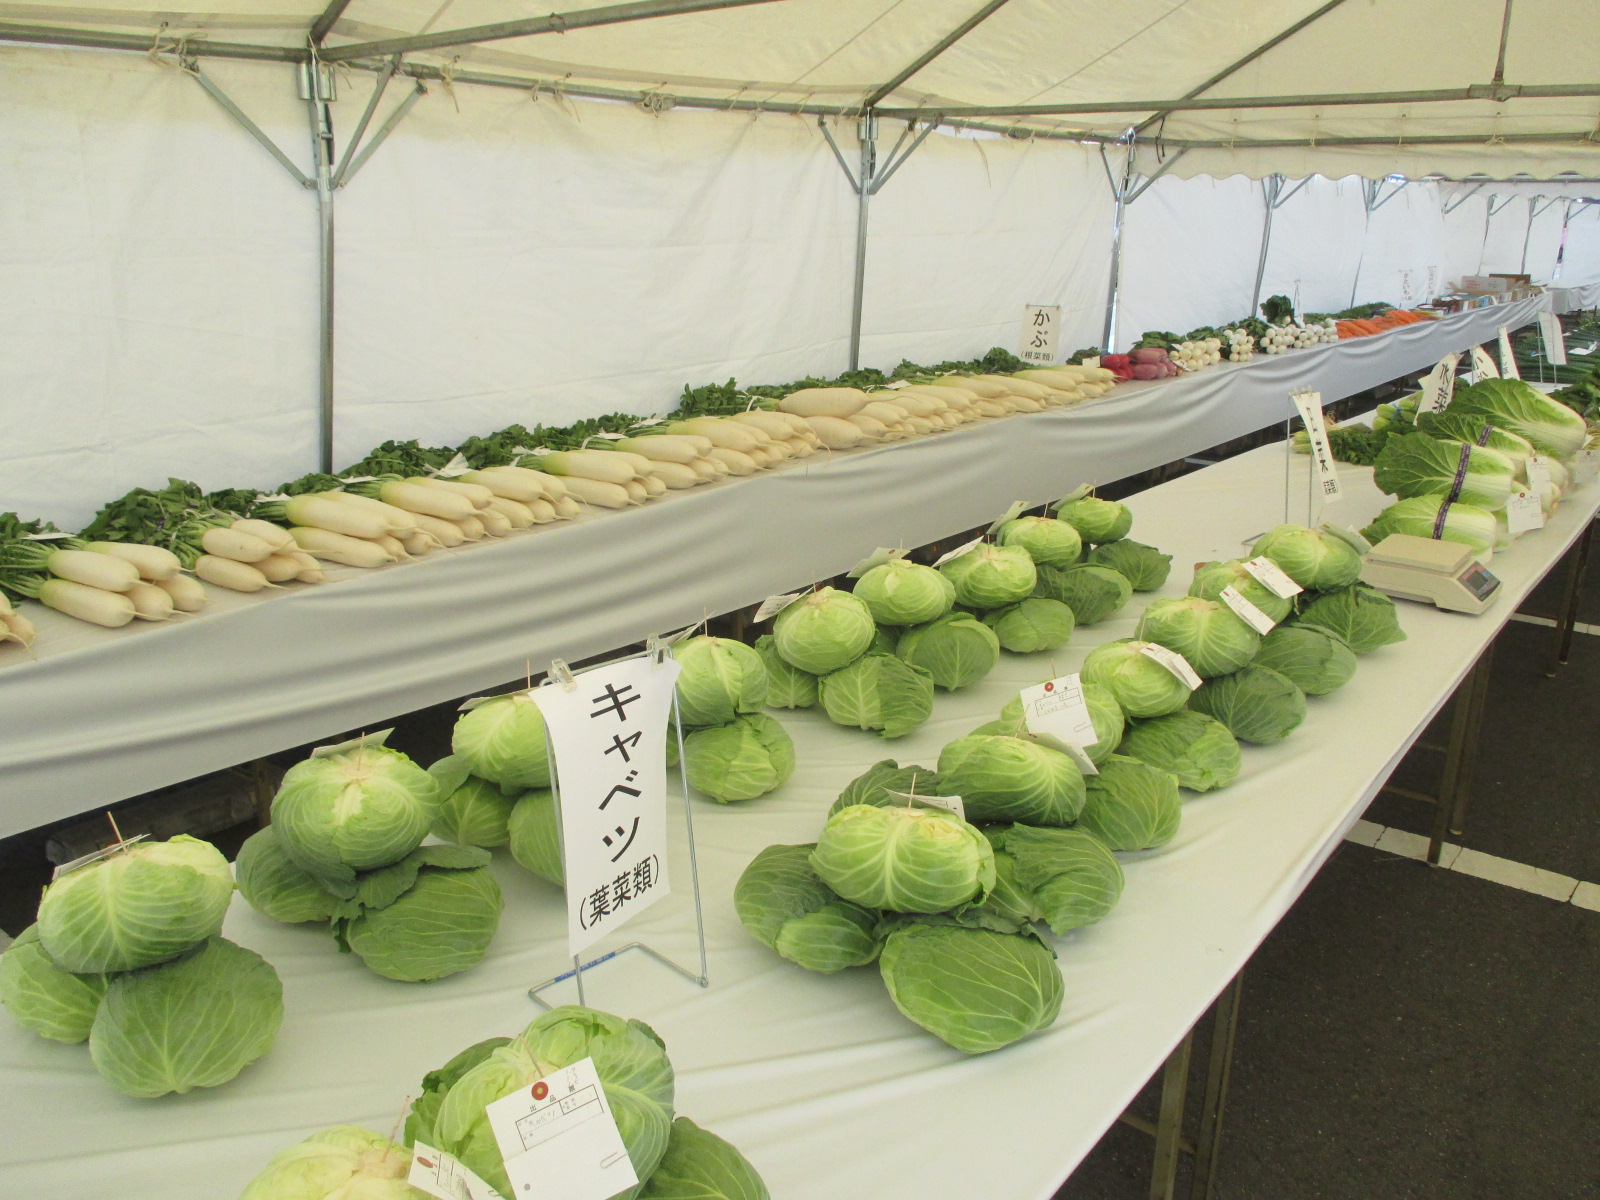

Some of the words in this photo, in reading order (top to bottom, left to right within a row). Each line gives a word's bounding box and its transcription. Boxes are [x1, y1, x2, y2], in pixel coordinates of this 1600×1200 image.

[1030, 309, 1050, 348] かぶ
[590, 683, 643, 863] キャベツ
[579, 854, 659, 931] (葉菜類)
